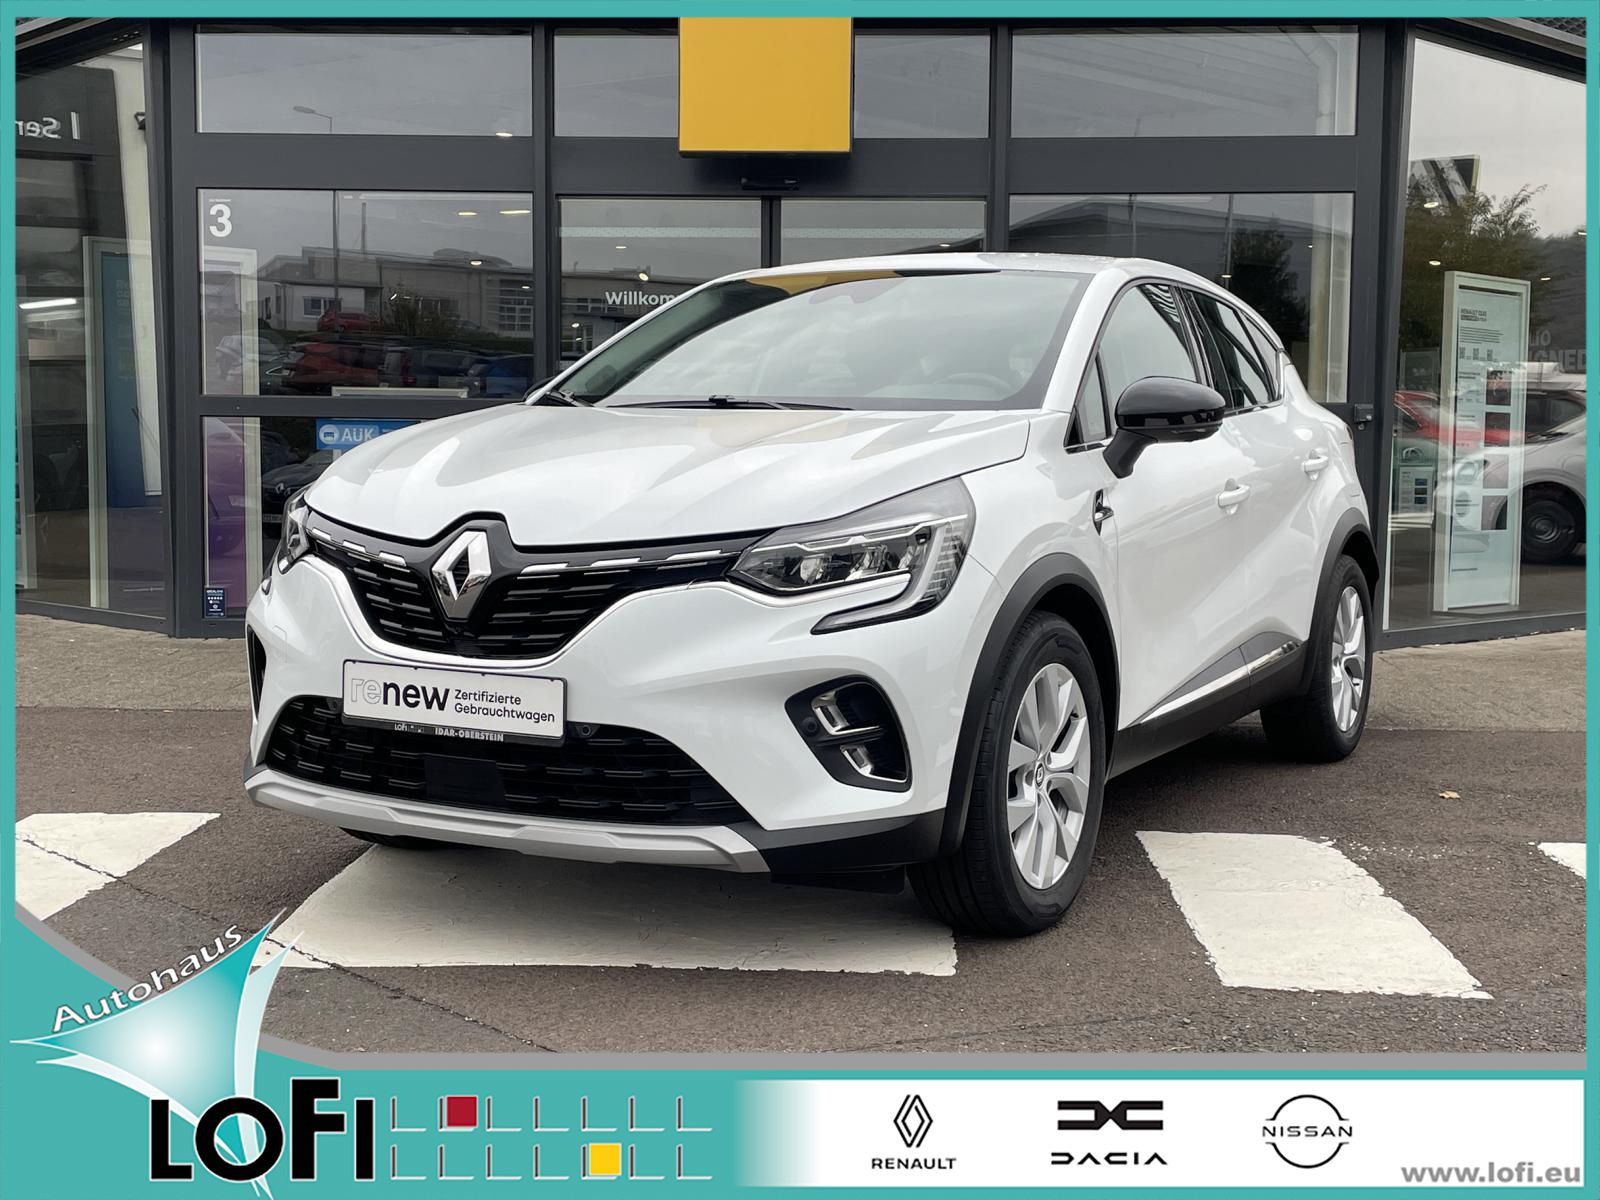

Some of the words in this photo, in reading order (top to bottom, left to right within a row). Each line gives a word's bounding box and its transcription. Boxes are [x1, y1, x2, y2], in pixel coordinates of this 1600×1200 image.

[209, 203, 232, 238] 3
[605, 291, 681, 305] Willkom
[350, 678, 450, 711] renew
[454, 689, 522, 706] Zertifizierte
[454, 702, 556, 724] Gebrauchtwagen
[434, 727, 504, 742] IDAR-OBERSTEIN
